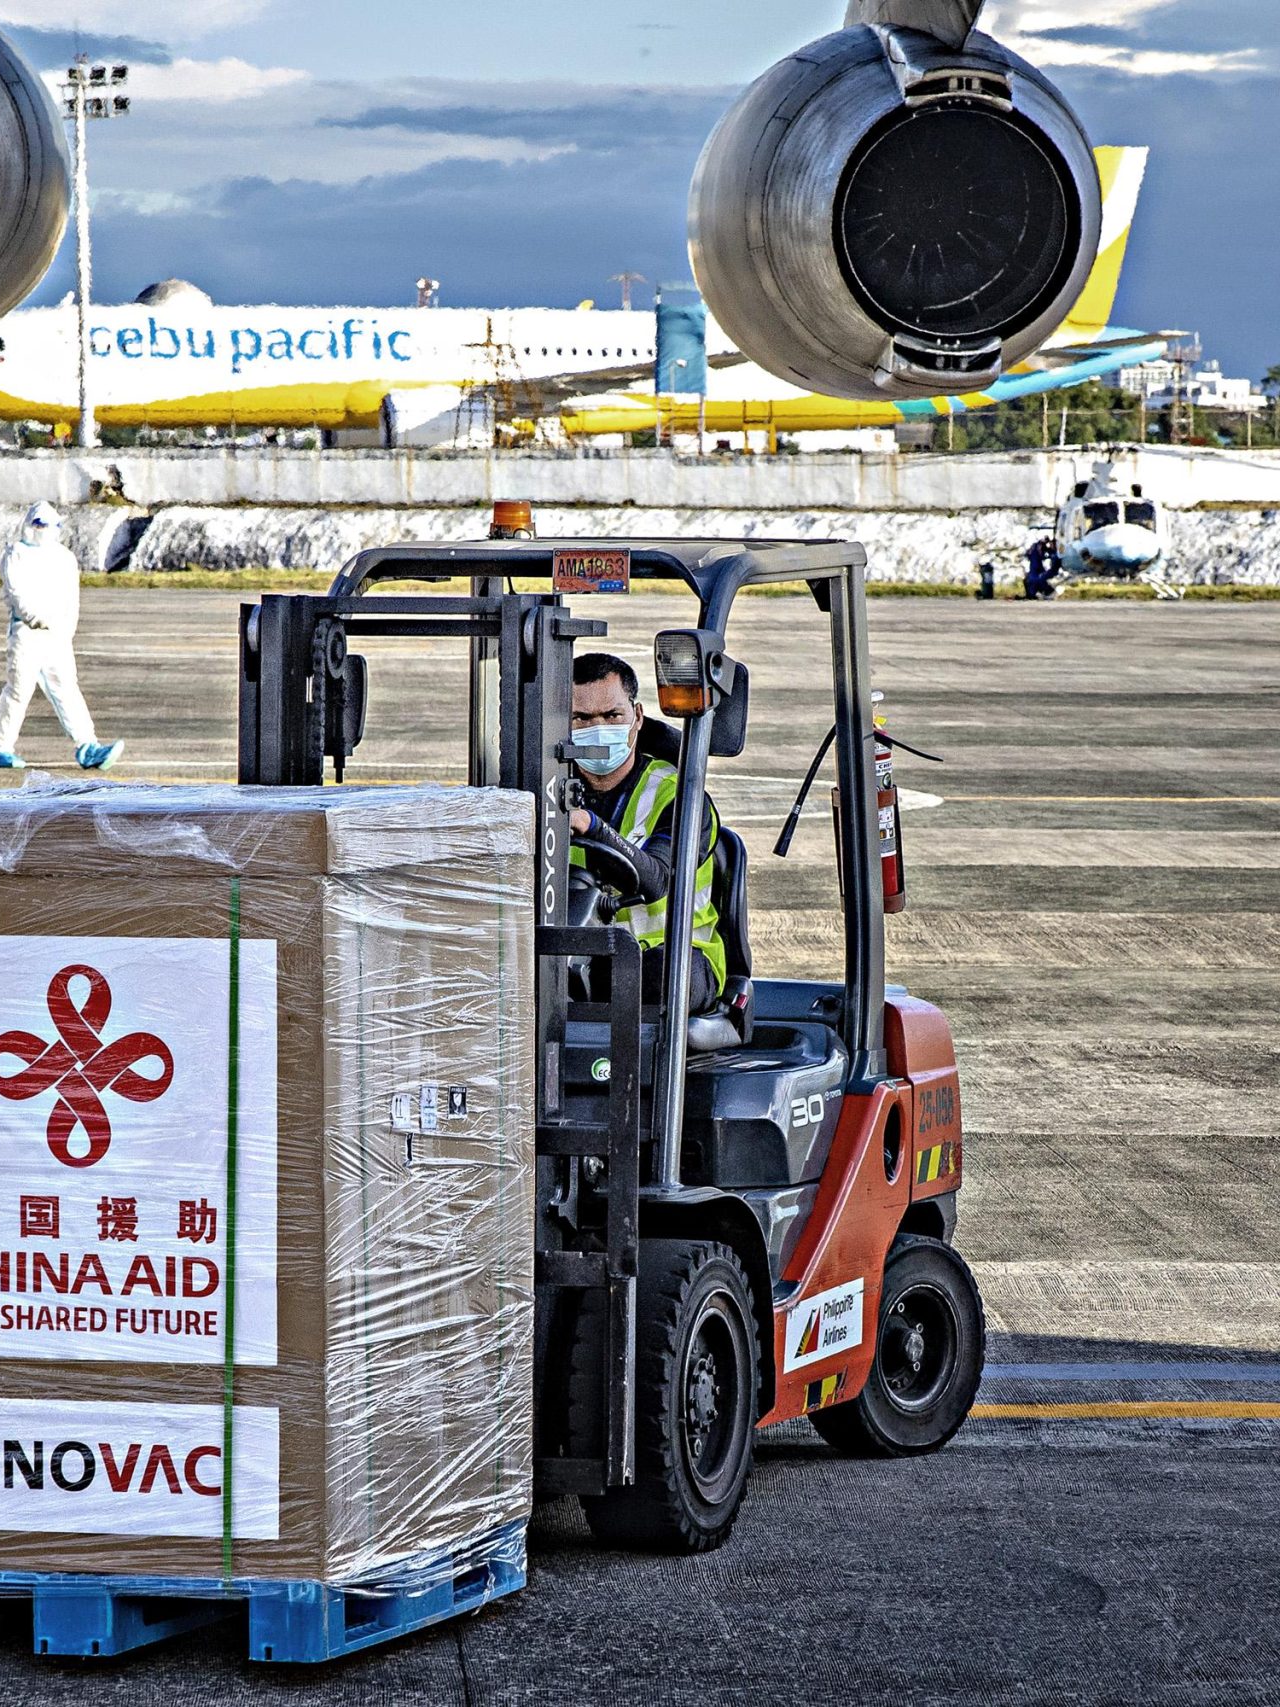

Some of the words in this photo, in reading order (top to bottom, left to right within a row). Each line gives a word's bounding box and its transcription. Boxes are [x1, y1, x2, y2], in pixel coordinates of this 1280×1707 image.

[89, 317, 215, 359] cebu
[230, 319, 412, 374] pacific
[790, 1093, 825, 1128] 30
[120, 1254, 220, 1298] AID
[0, 1304, 107, 1333] SHARED
[115, 1307, 218, 1336] FUTURE
[822, 1294, 855, 1320] Philippine
[822, 1325, 848, 1347] Airlines
